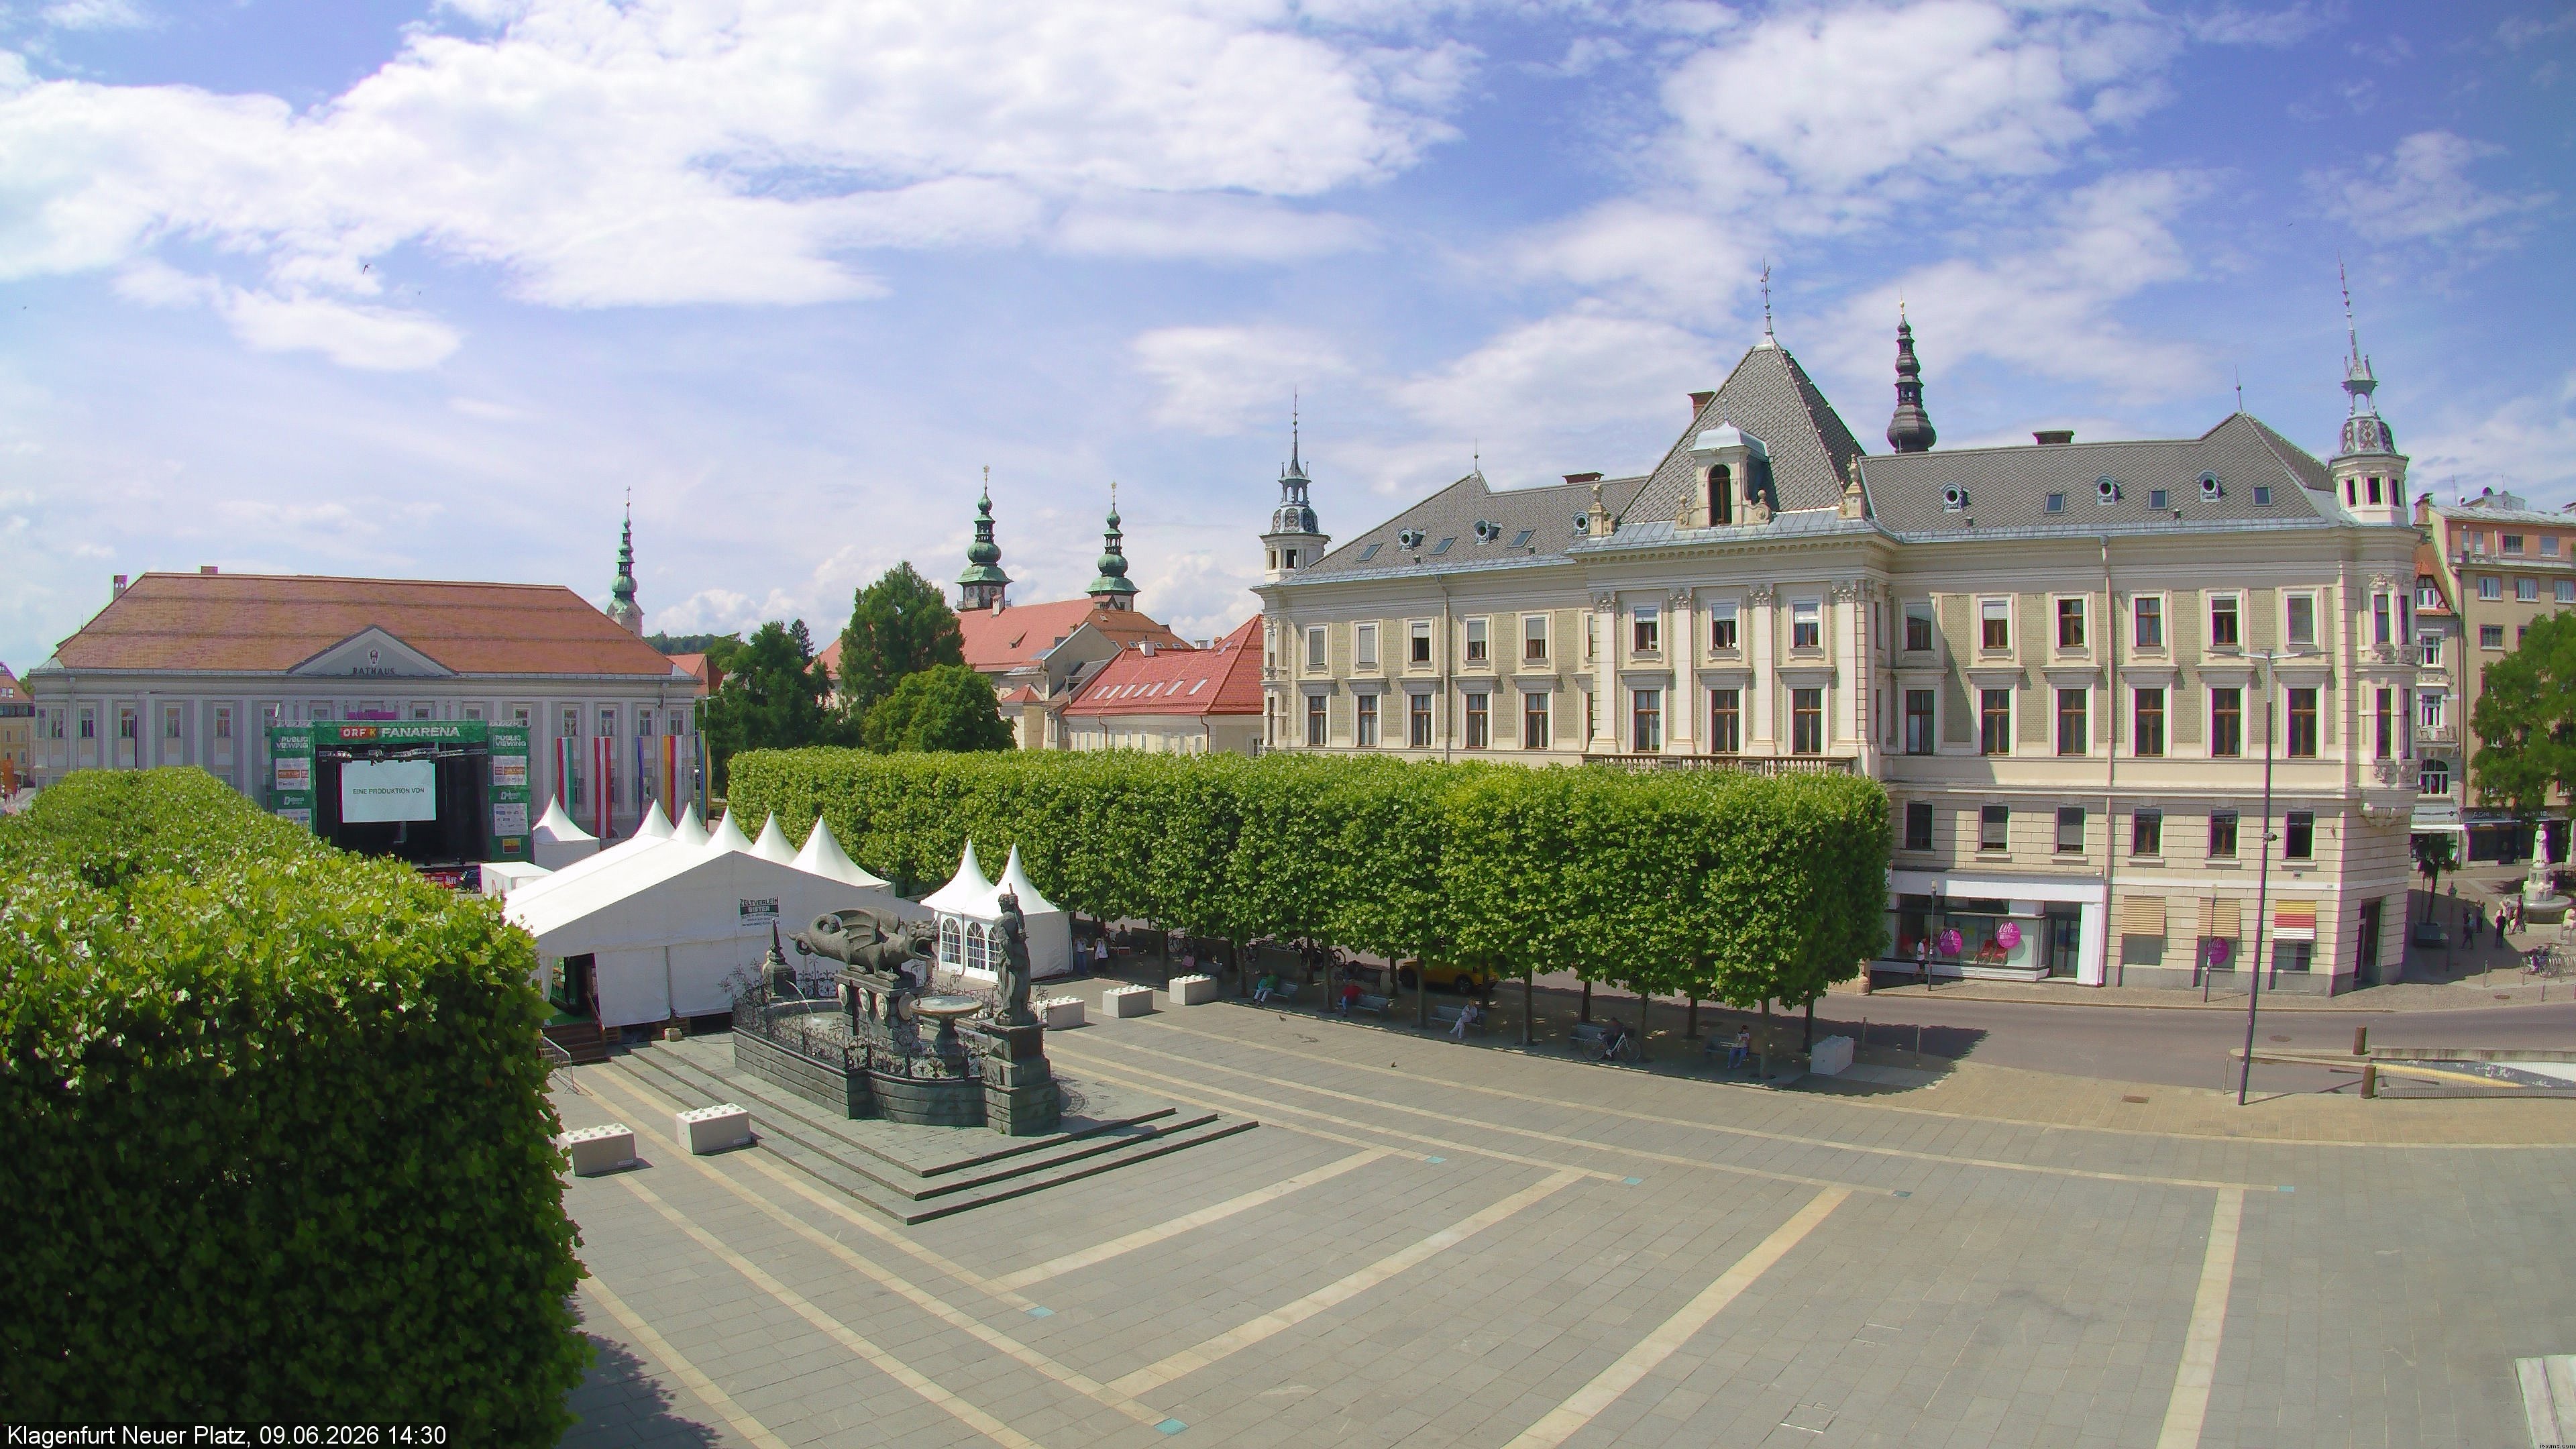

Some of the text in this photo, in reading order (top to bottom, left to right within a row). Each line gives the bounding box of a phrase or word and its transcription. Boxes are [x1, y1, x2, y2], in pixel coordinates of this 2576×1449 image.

[353, 667, 395, 676] RATHAUS
[343, 729, 366, 737] ORF
[381, 727, 460, 737] FANARENA
